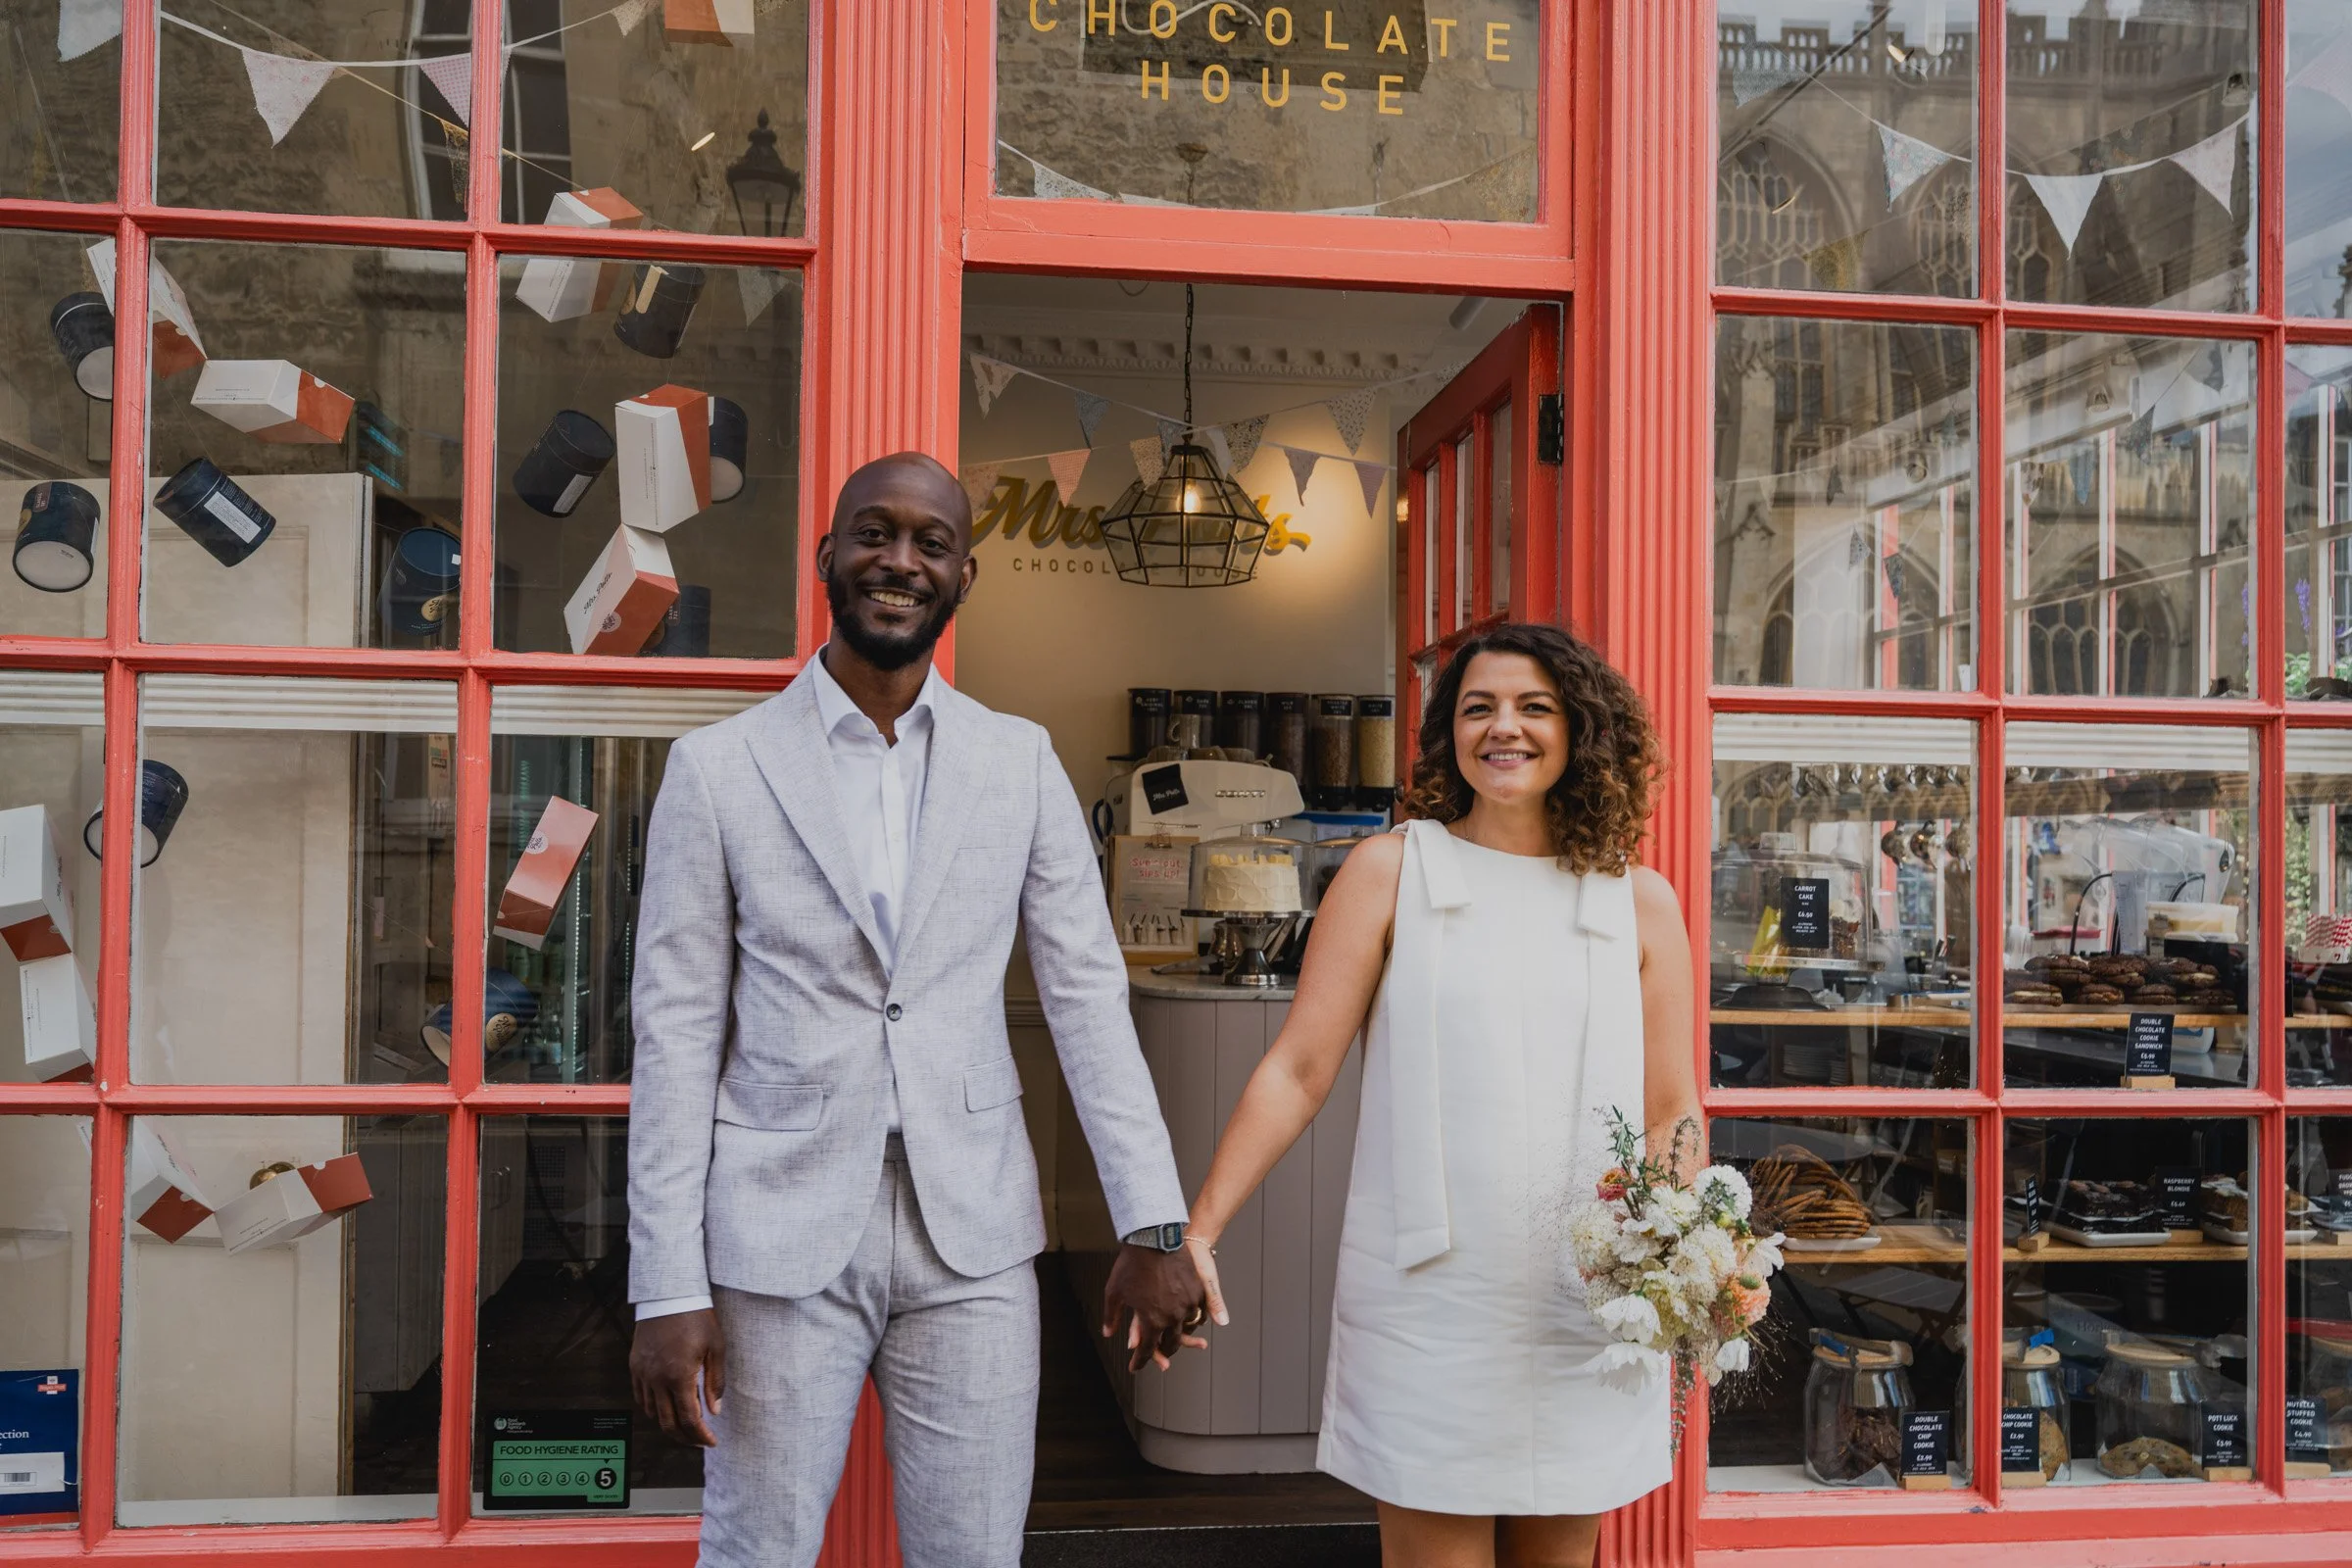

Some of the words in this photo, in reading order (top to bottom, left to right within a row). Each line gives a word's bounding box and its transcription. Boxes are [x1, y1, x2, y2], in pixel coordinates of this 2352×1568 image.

[1029, 0, 1511, 63] CHOCOLATE
[1142, 60, 1405, 116] HOUSE
[972, 476, 1105, 544] Mrs
[2286, 1409, 2316, 1418] STUFFED
[1909, 1423, 1942, 1432] CHOCOLATE
[500, 1446, 532, 1455] FOOD
[534, 1446, 579, 1455] HYGIENE
[581, 1445, 619, 1454] RATING
[600, 1470, 612, 1487] 5
